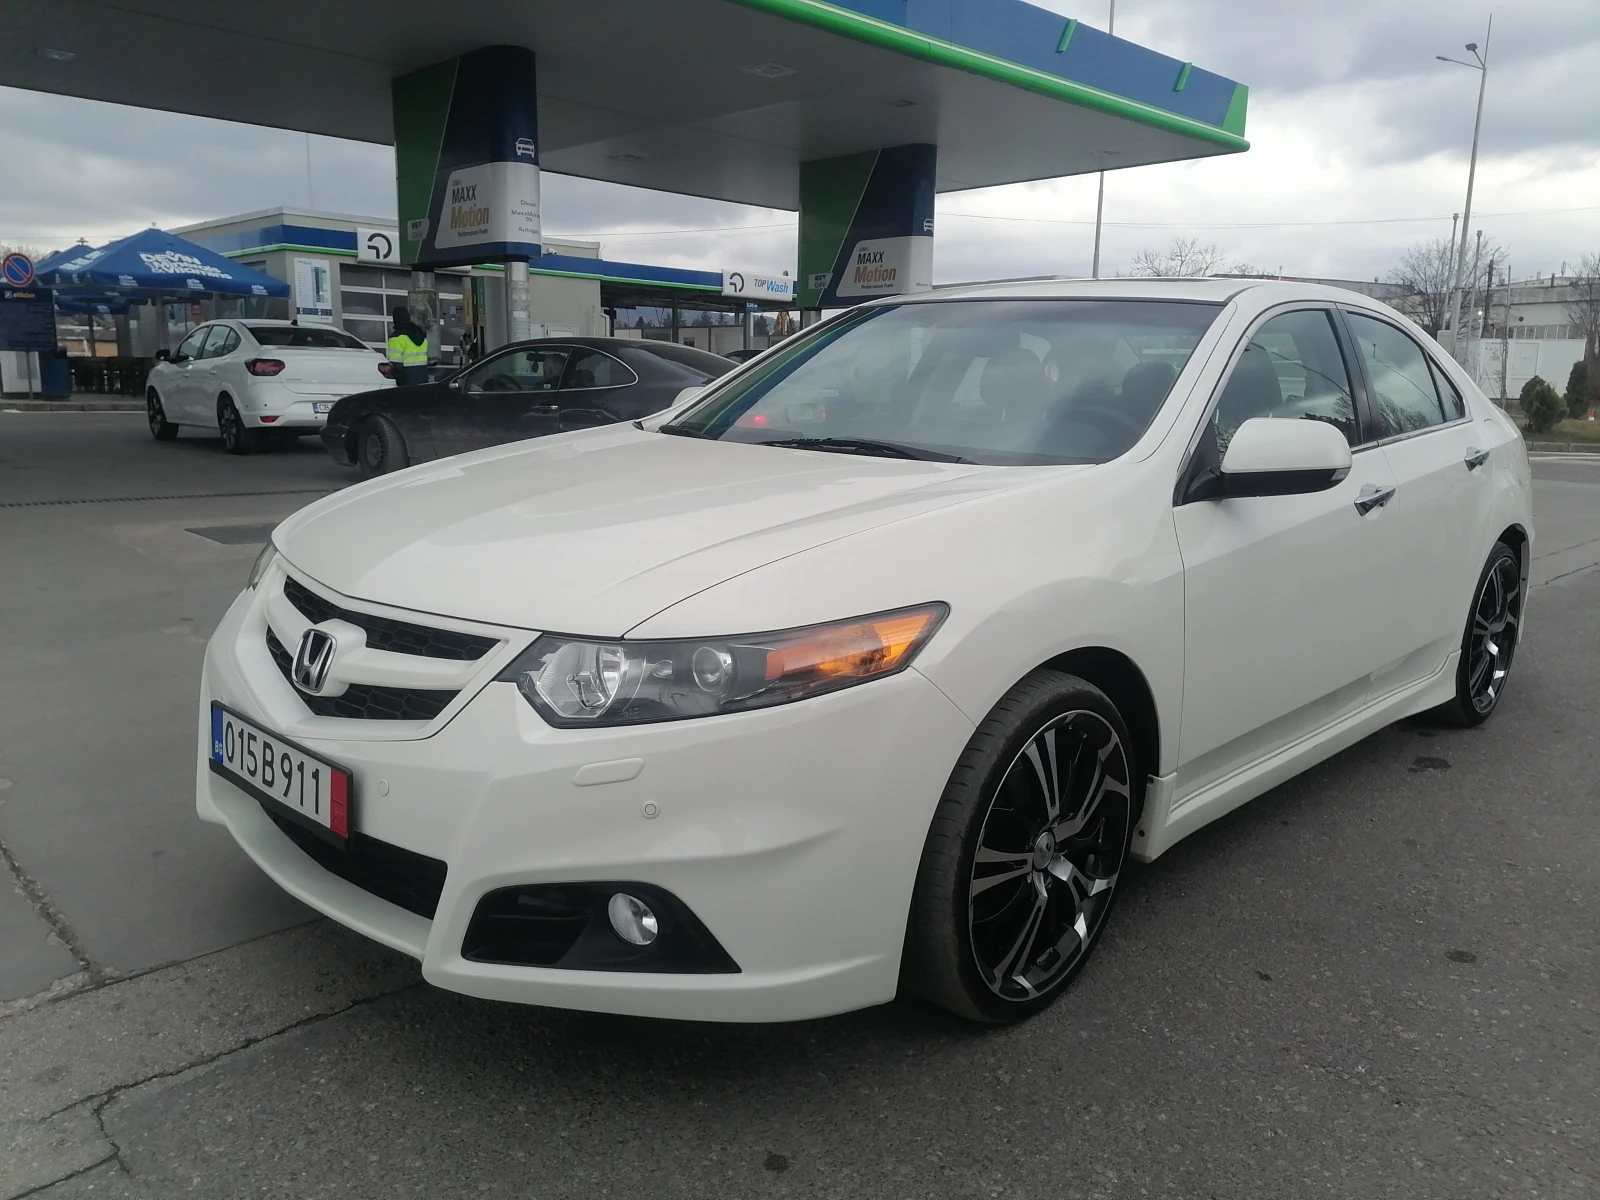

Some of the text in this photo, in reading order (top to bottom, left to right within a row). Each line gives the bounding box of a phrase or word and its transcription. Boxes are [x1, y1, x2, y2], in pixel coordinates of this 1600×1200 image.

[452, 184, 477, 204] MAXX
[450, 203, 490, 230] Motion
[140, 250, 202, 265] DEVIN
[856, 250, 885, 265] MAXX
[853, 265, 897, 284] Motion
[754, 278, 789, 294] TOP Wash
[214, 740, 223, 756] BG
[225, 720, 320, 816] 015B911
